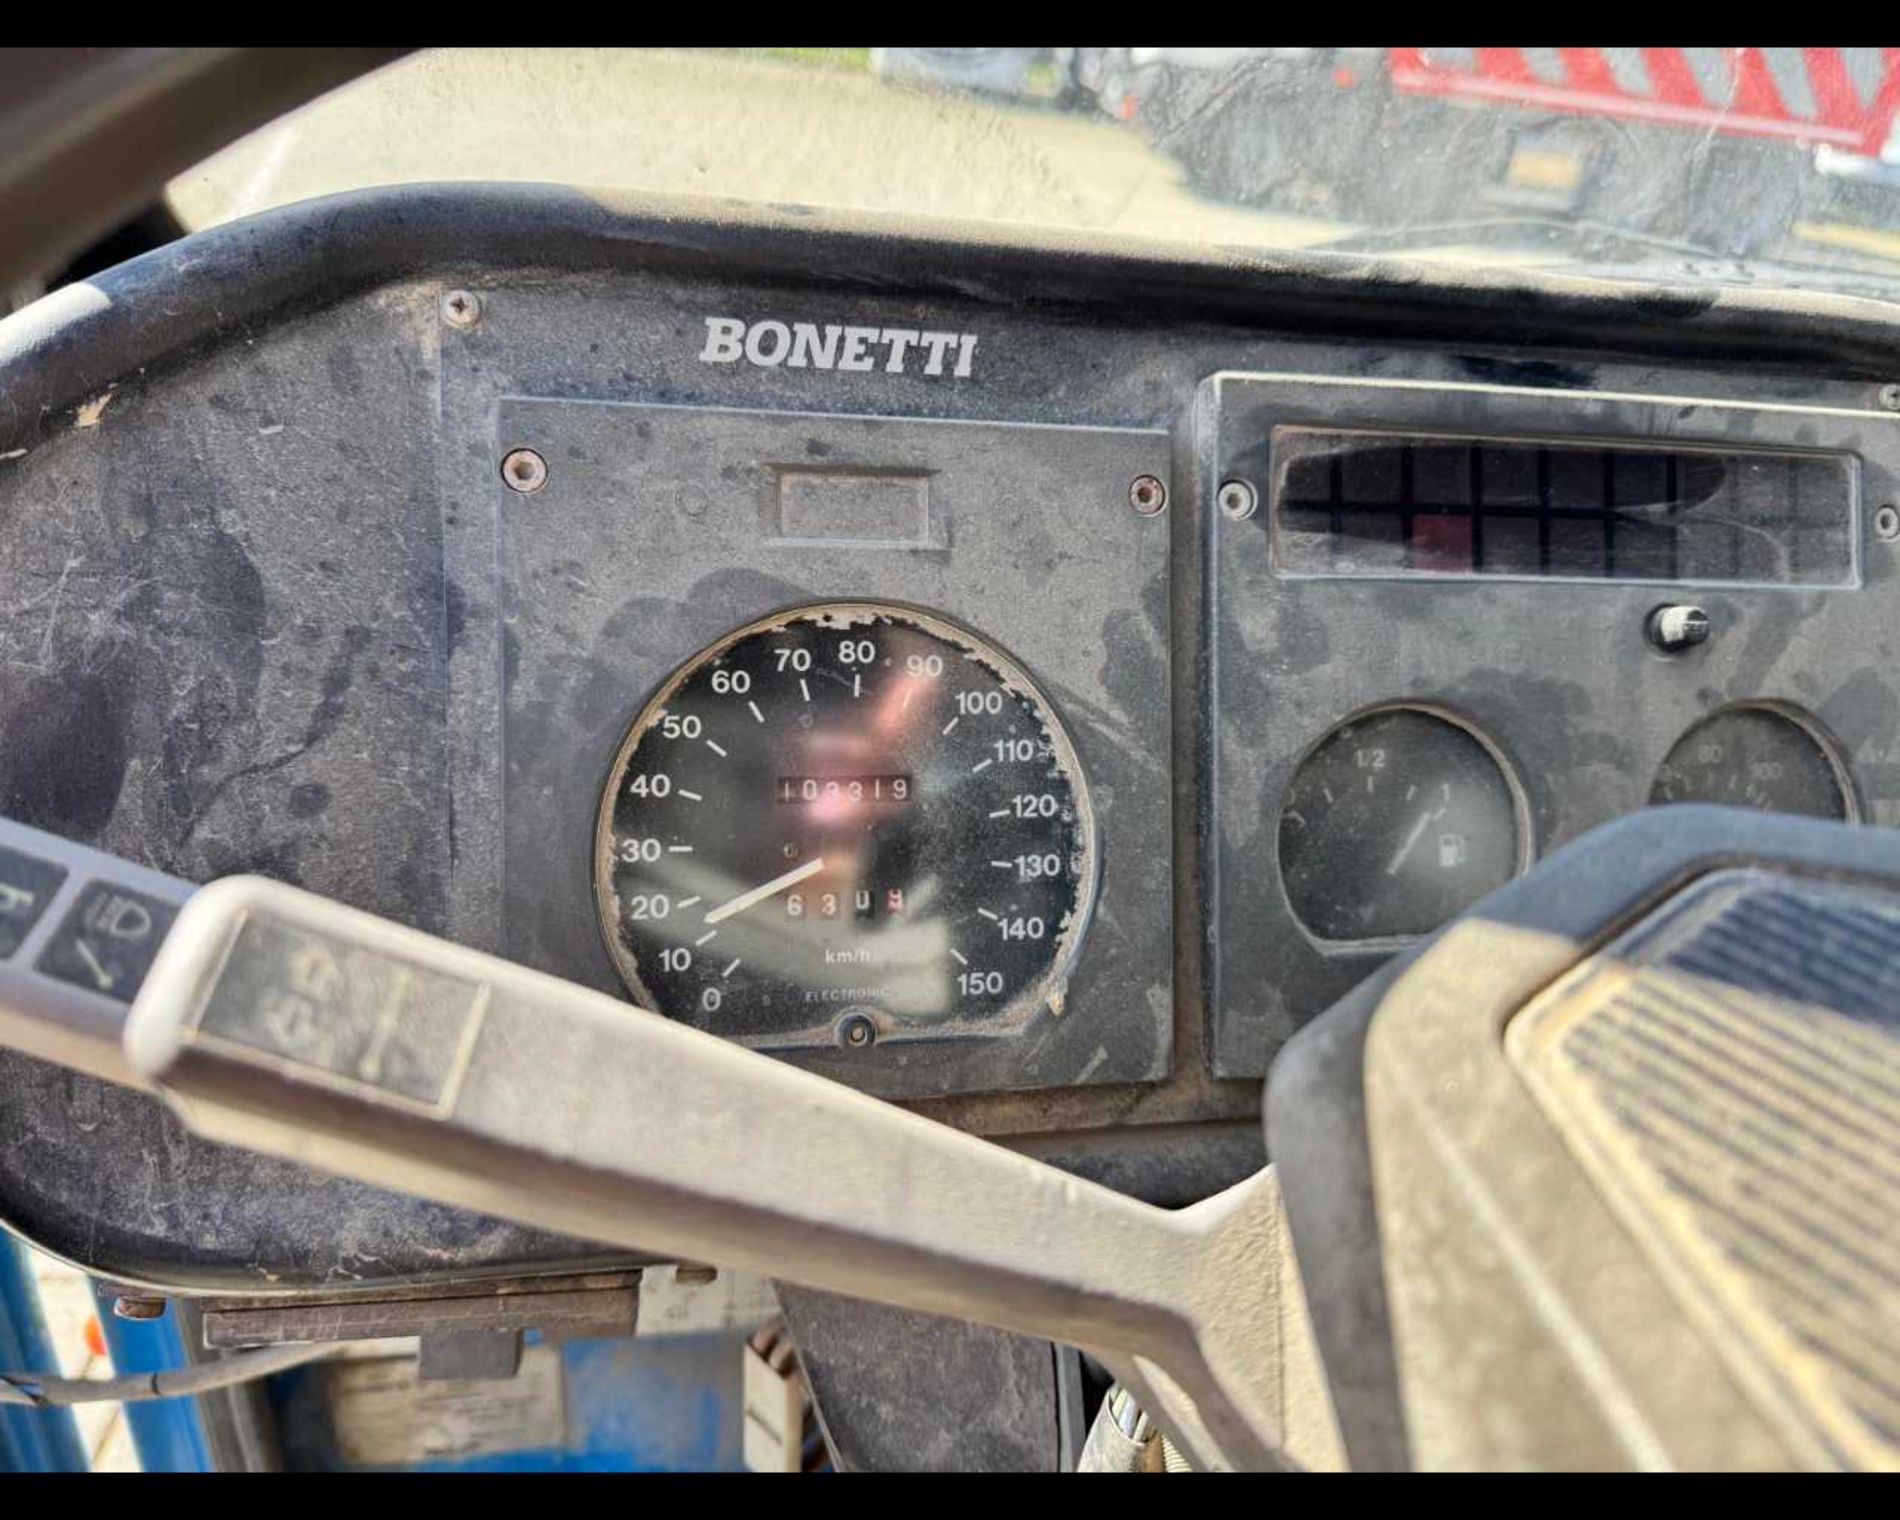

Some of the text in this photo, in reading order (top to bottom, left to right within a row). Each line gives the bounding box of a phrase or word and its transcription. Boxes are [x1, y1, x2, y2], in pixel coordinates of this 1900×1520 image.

[699, 316, 978, 377] BONETTI
[774, 648, 812, 672] 70
[838, 640, 875, 664] 80
[906, 655, 943, 677] 90
[711, 670, 750, 693] 60
[955, 691, 1002, 715] 100
[662, 715, 702, 739] 50
[994, 739, 1034, 762] 110
[630, 774, 671, 798] 40
[1012, 794, 1058, 818] 120
[620, 838, 662, 862] 30
[1014, 854, 1060, 877] 130
[631, 894, 670, 920] 20
[997, 917, 1045, 941] 140
[658, 948, 692, 972] 10
[825, 949, 871, 962] km/h
[957, 971, 1004, 996] 150
[702, 987, 722, 1012] 0
